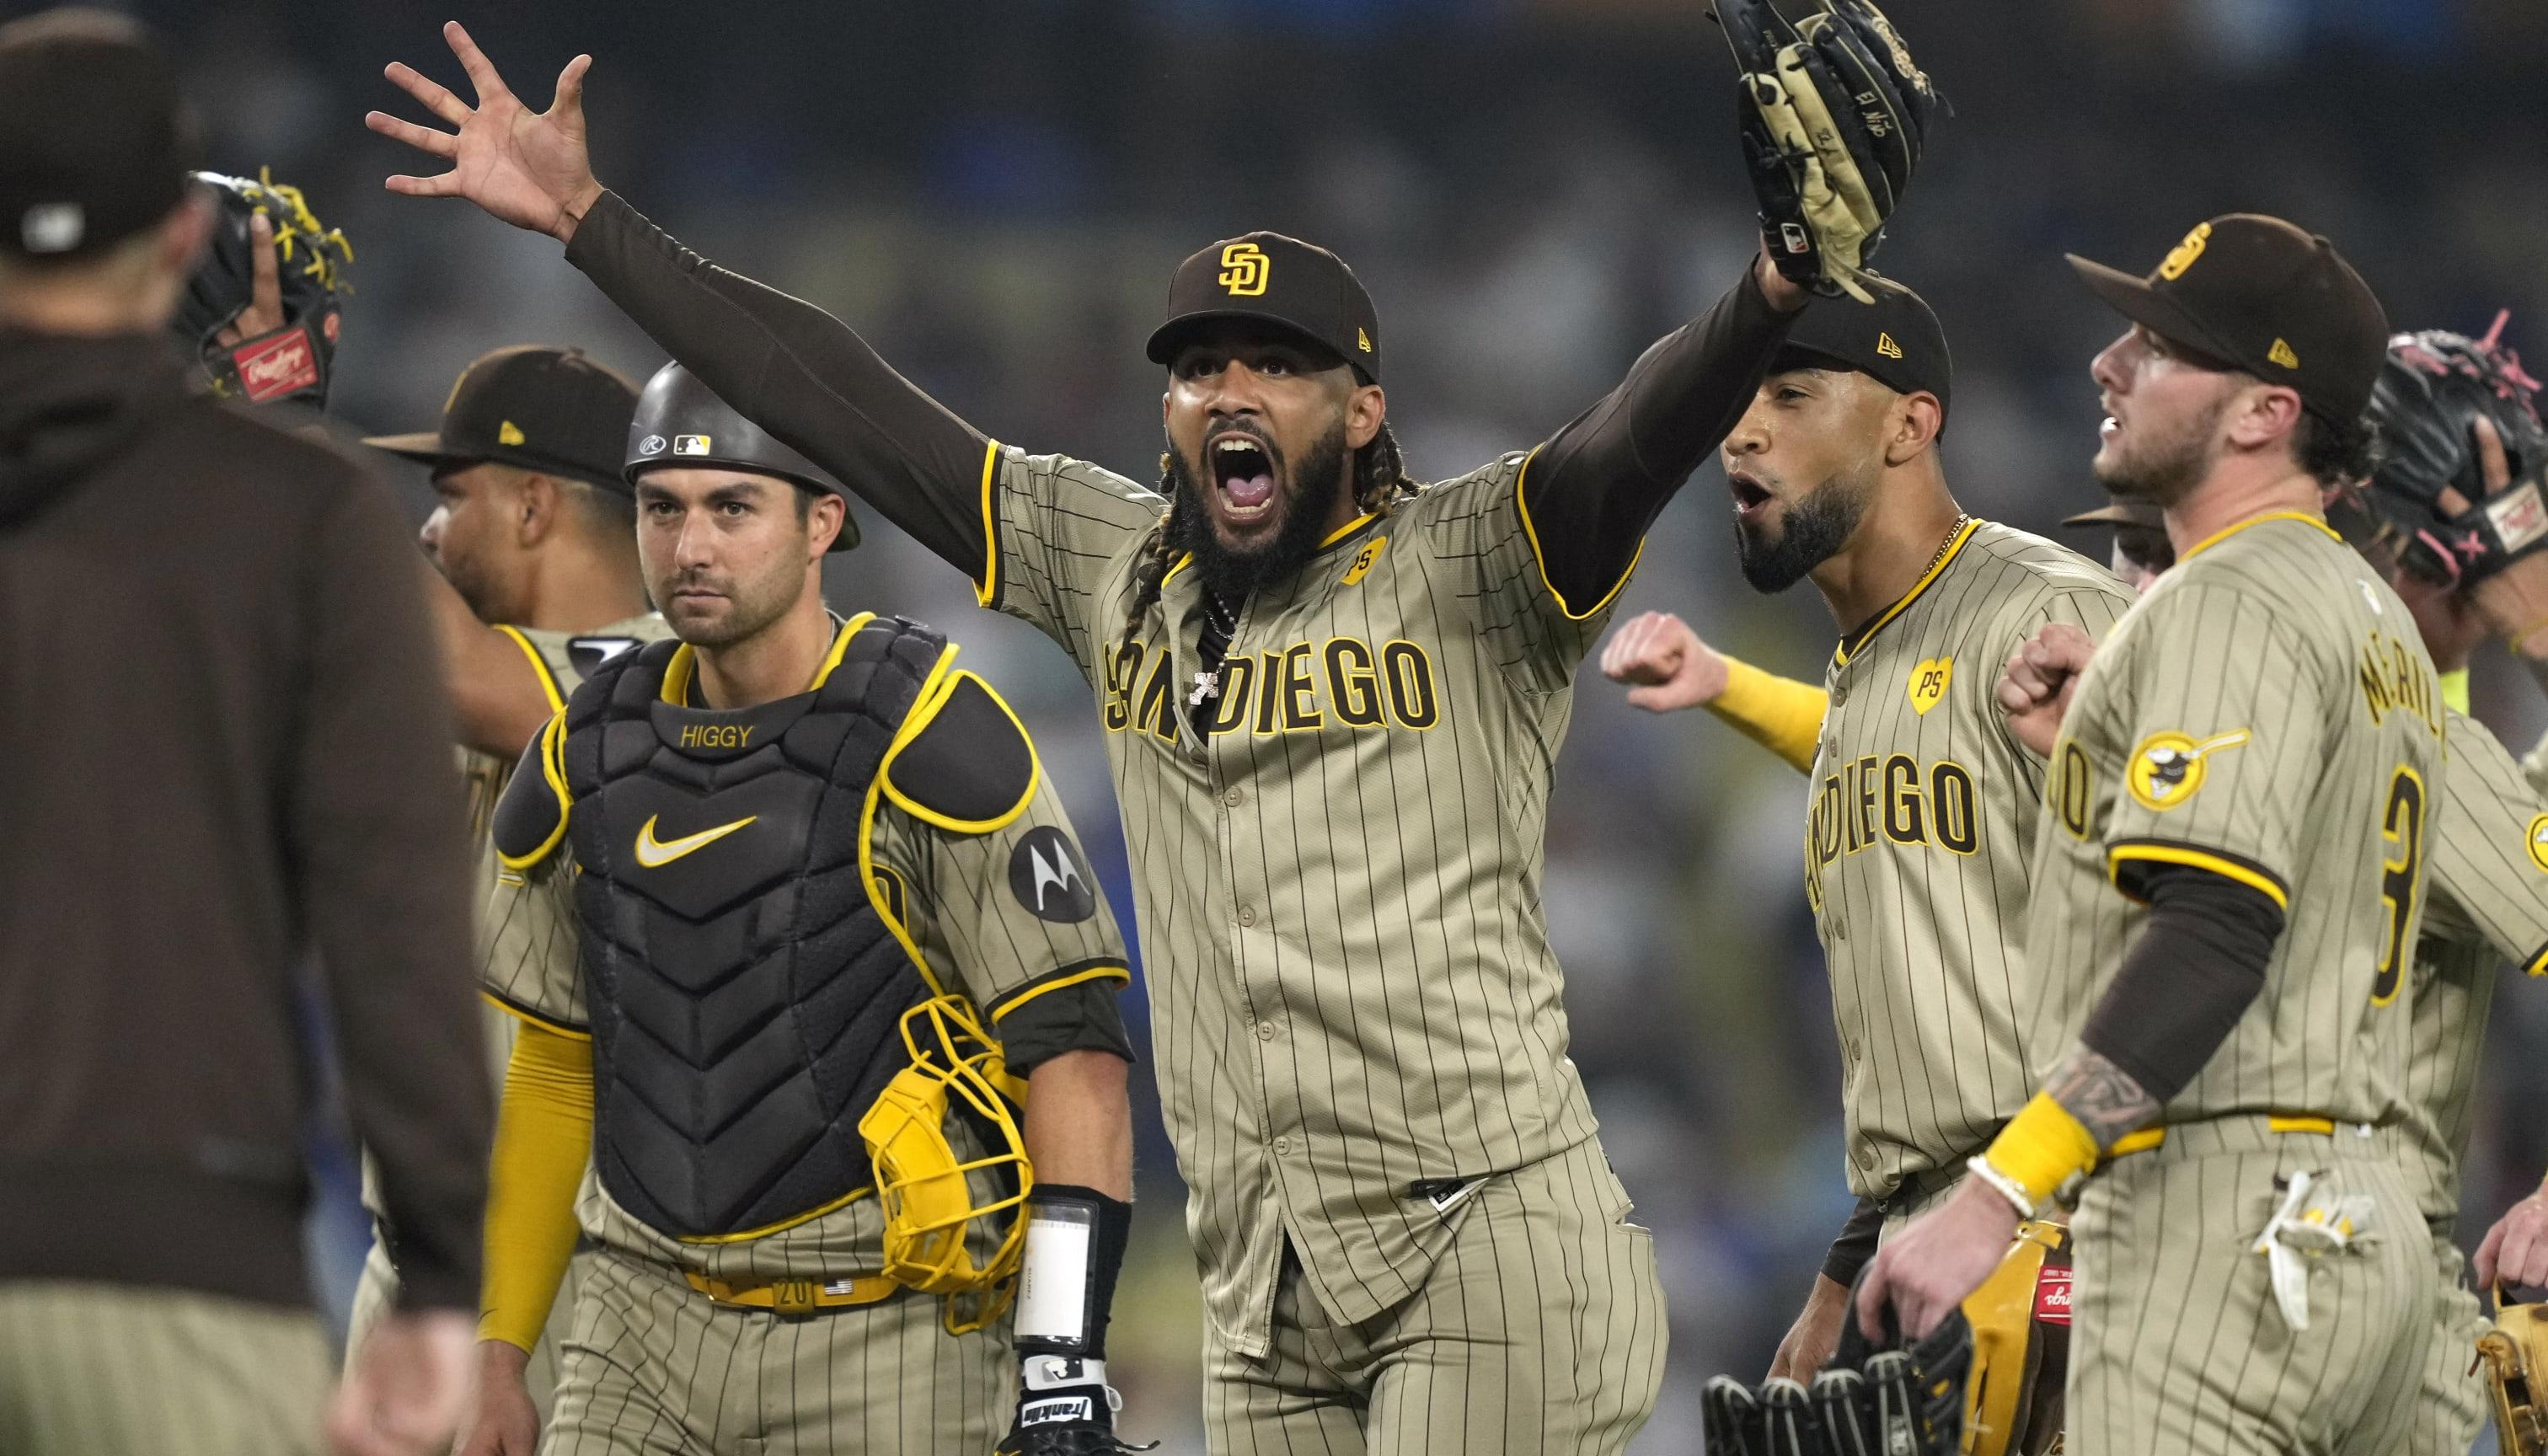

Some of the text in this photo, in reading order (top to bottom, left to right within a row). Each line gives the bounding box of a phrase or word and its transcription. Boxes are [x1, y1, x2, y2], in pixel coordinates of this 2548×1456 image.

[1218, 243, 1271, 296] SD
[1208, 636, 1440, 737] DIEGO
[1917, 670, 1943, 698] PS
[680, 725, 755, 748] HIGGY
[1823, 752, 1979, 865] DIEGO
[2370, 763, 2427, 1009] 3
[779, 1278, 807, 1304] 20
